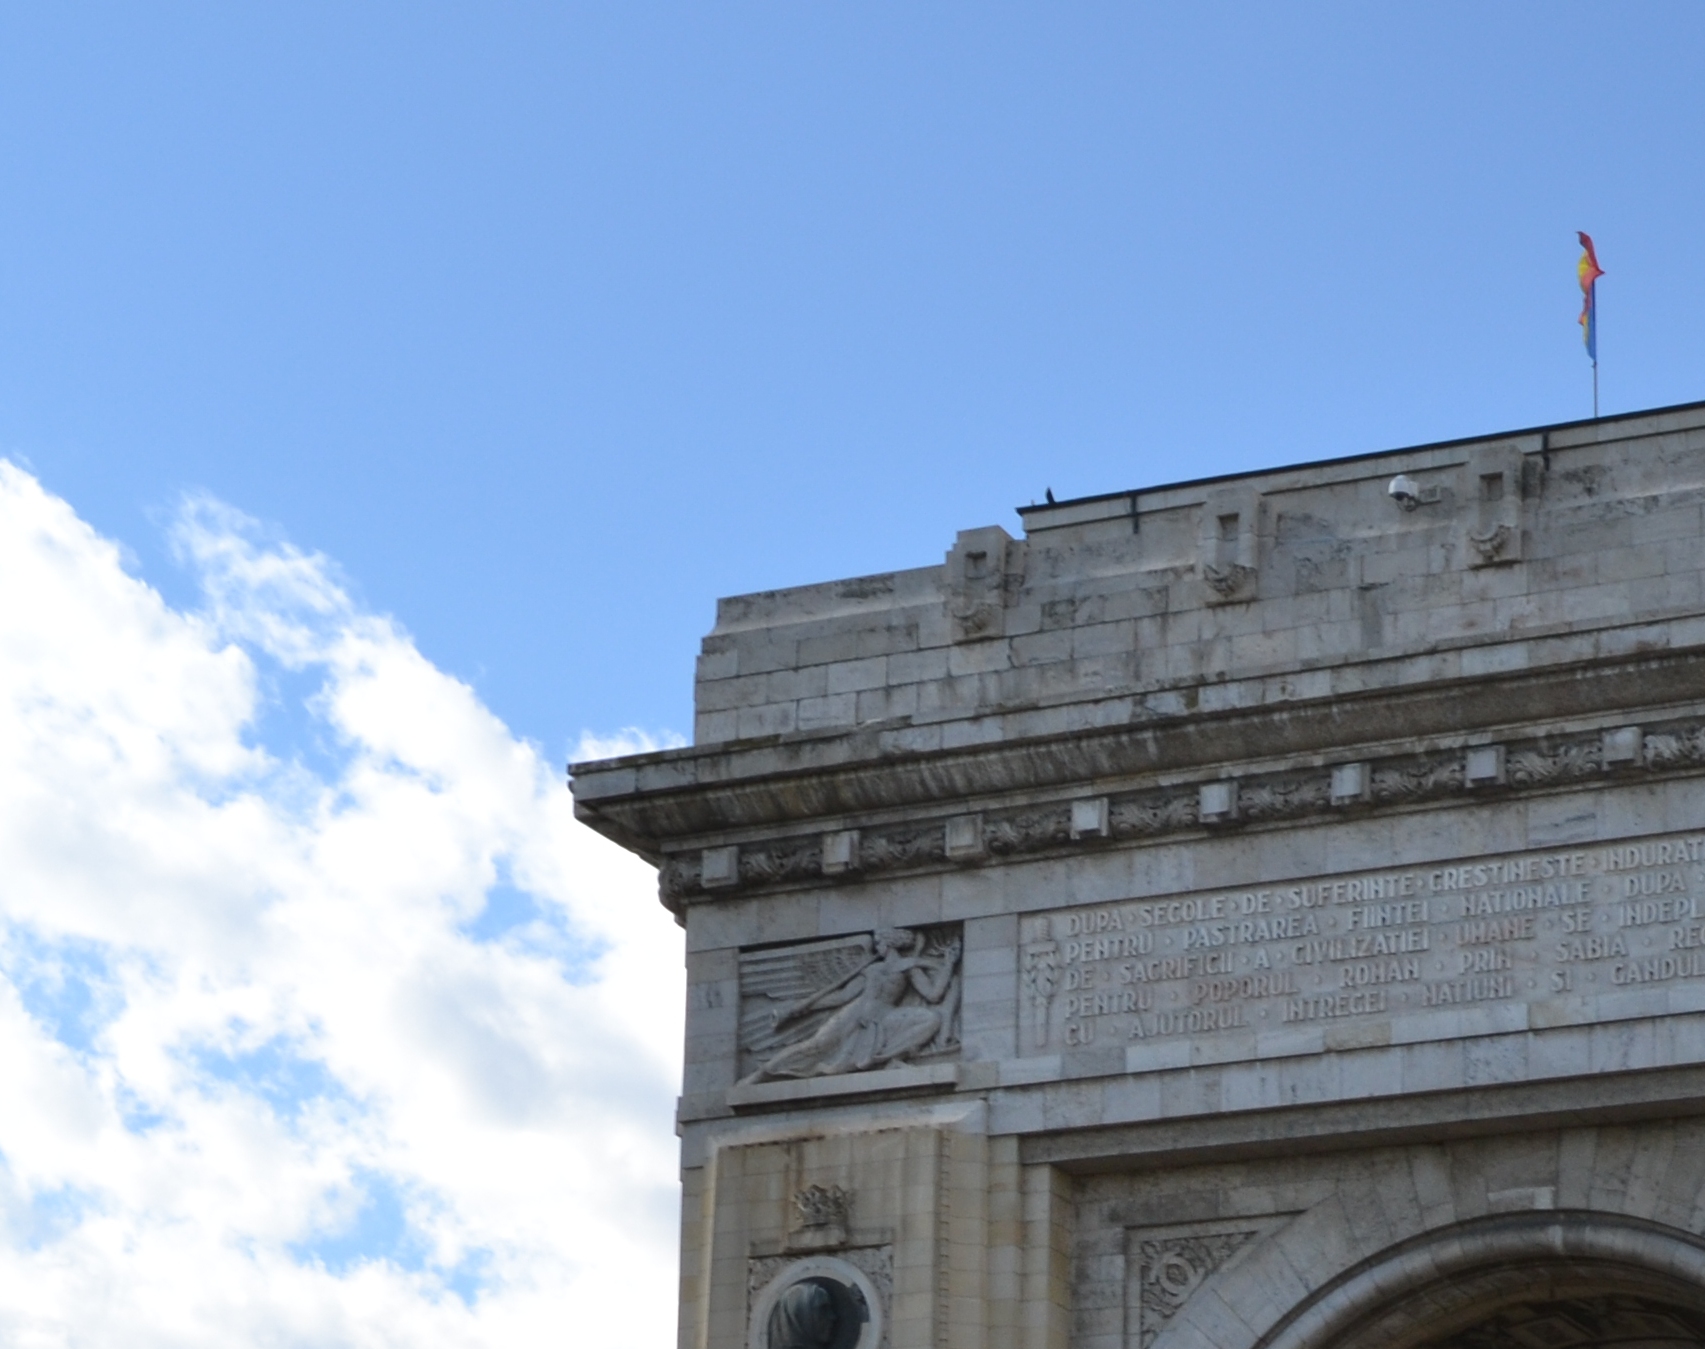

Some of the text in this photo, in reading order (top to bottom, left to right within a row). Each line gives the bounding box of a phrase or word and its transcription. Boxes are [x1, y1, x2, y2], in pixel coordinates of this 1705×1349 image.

[1065, 932, 1154, 964] PENTRU
[1184, 913, 1320, 950] PASTRAREA
[1348, 901, 1429, 931] FIINTEI
[1460, 881, 1592, 917] NATIONALE
[1625, 870, 1686, 898] DUPA
[1067, 909, 1122, 937] DUPA
[1141, 897, 1225, 927] SECOLE
[1241, 890, 1271, 915] DE
[1288, 874, 1415, 910] SUFERINTE
[1430, 853, 1585, 892] CRESTINESTE
[1064, 967, 1095, 991] DE
[1120, 951, 1234, 985] SACRIFICII
[1254, 947, 1272, 970] A
[1292, 928, 1431, 965] CIVILIZATIEI
[1455, 916, 1536, 947] UMANE
[1562, 908, 1592, 934] SE
[1064, 990, 1153, 1019] PENTRU
[1192, 972, 1300, 1005] POPORUL
[1339, 958, 1420, 989] ROMAN
[1458, 949, 1512, 975] PRIN
[1556, 932, 1629, 963] SABIA
[1064, 1022, 1094, 1047] CU
[1128, 1005, 1248, 1040] AJUTORUL
[1283, 989, 1388, 1023] INTREGEI
[1422, 975, 1514, 1007] NATIUNI
